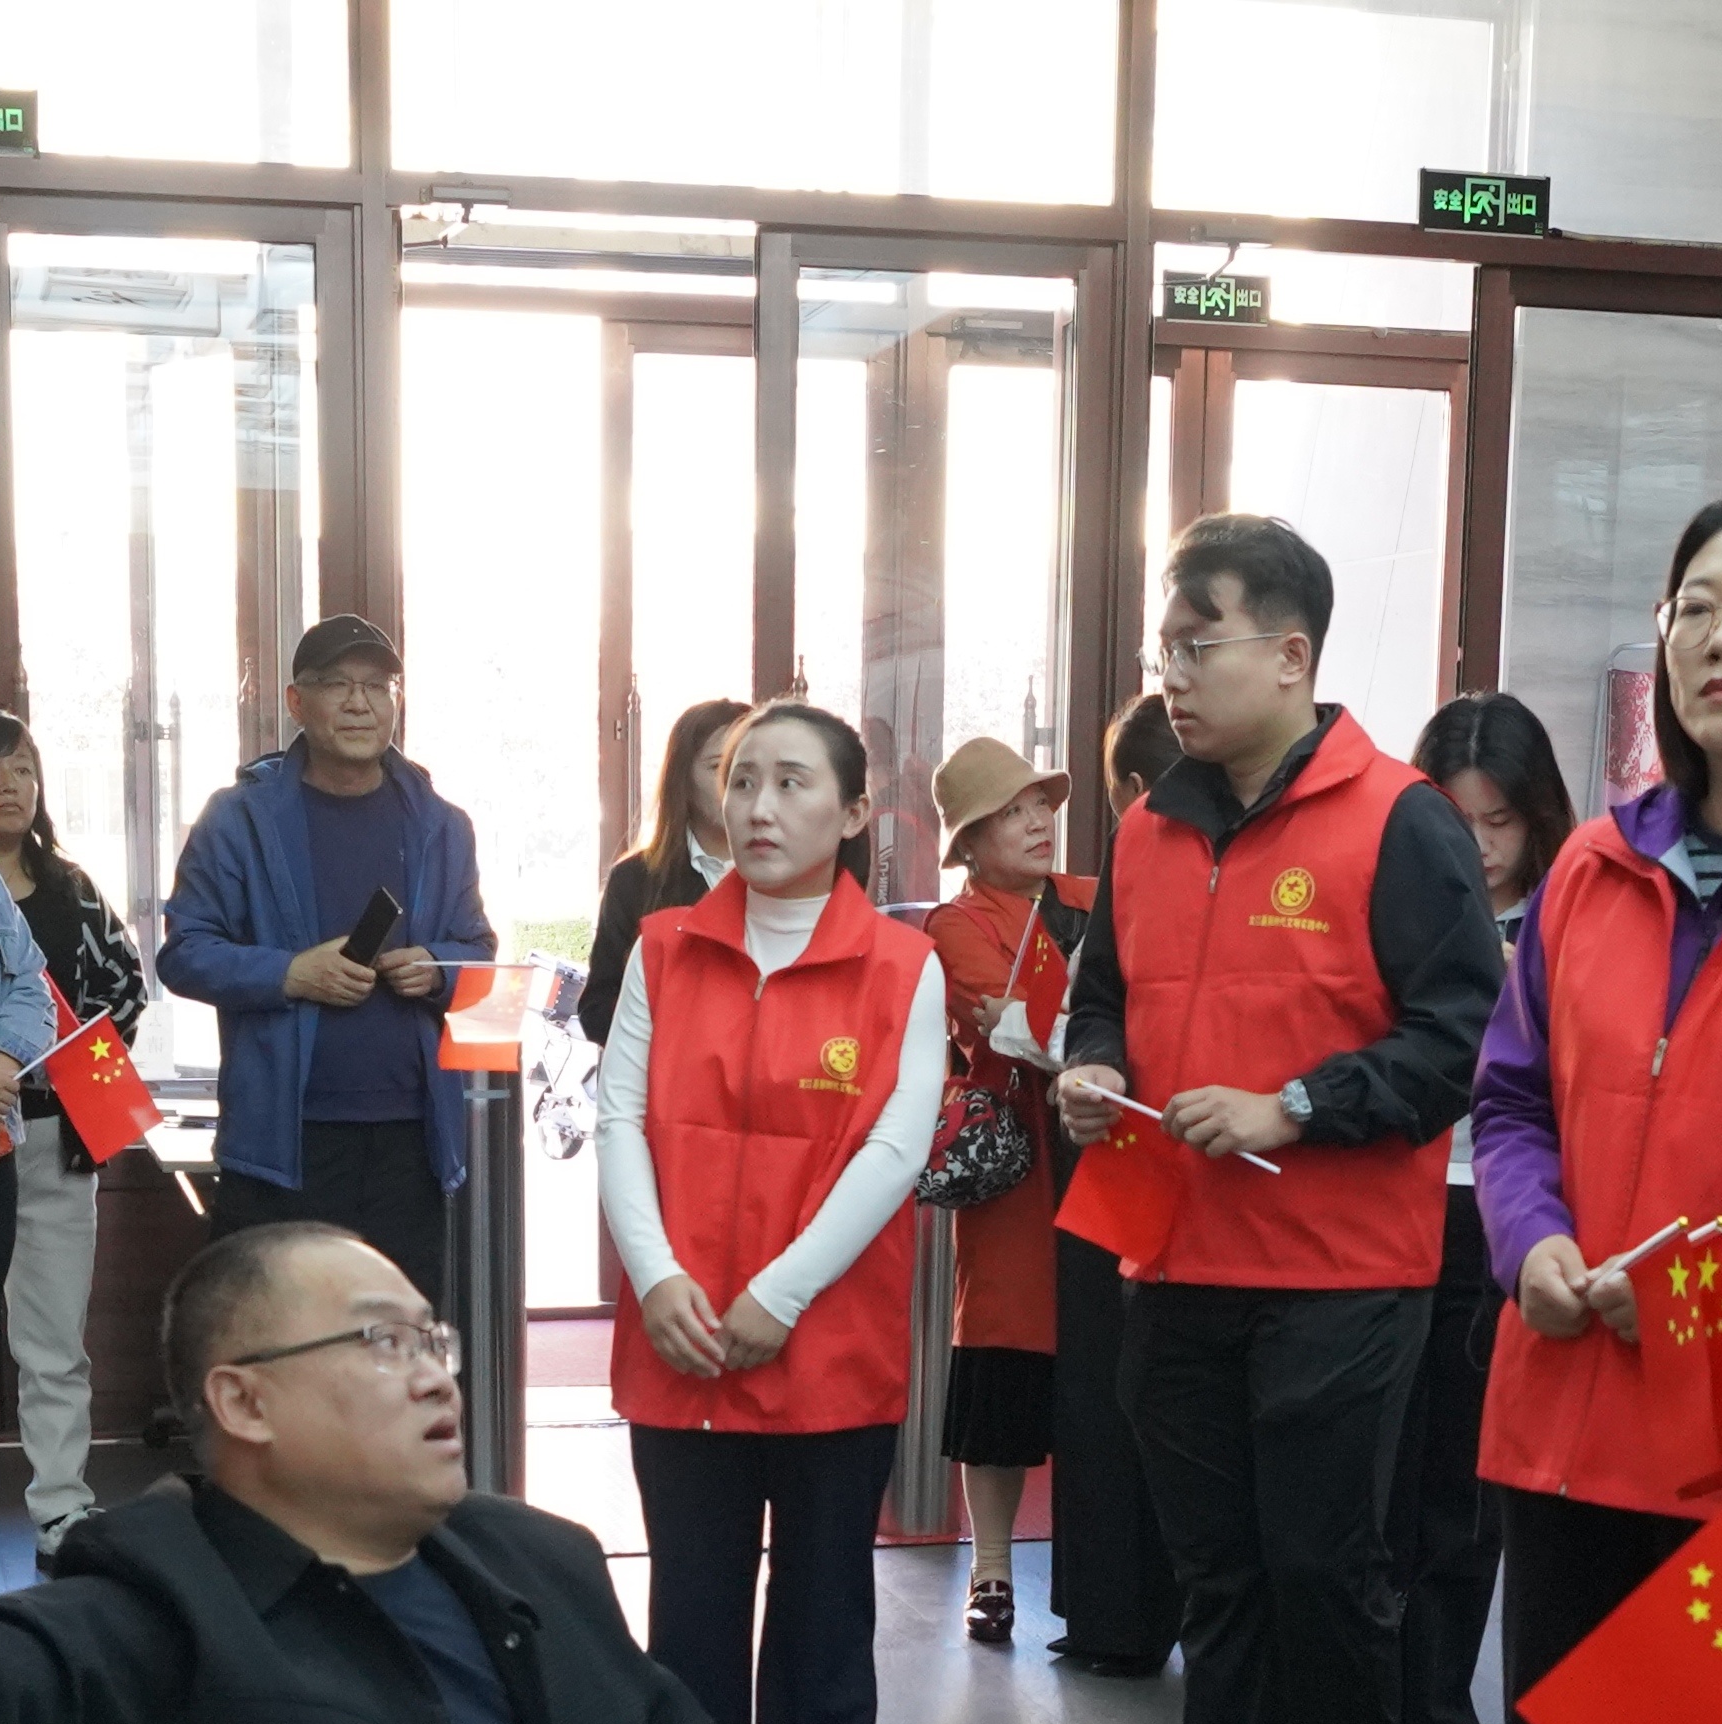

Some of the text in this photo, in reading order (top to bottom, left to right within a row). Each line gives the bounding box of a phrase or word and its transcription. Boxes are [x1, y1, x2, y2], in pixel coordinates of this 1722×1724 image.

[1433, 188, 1537, 217] 安全 出口
[1174, 285, 1262, 308] 安全 出口
